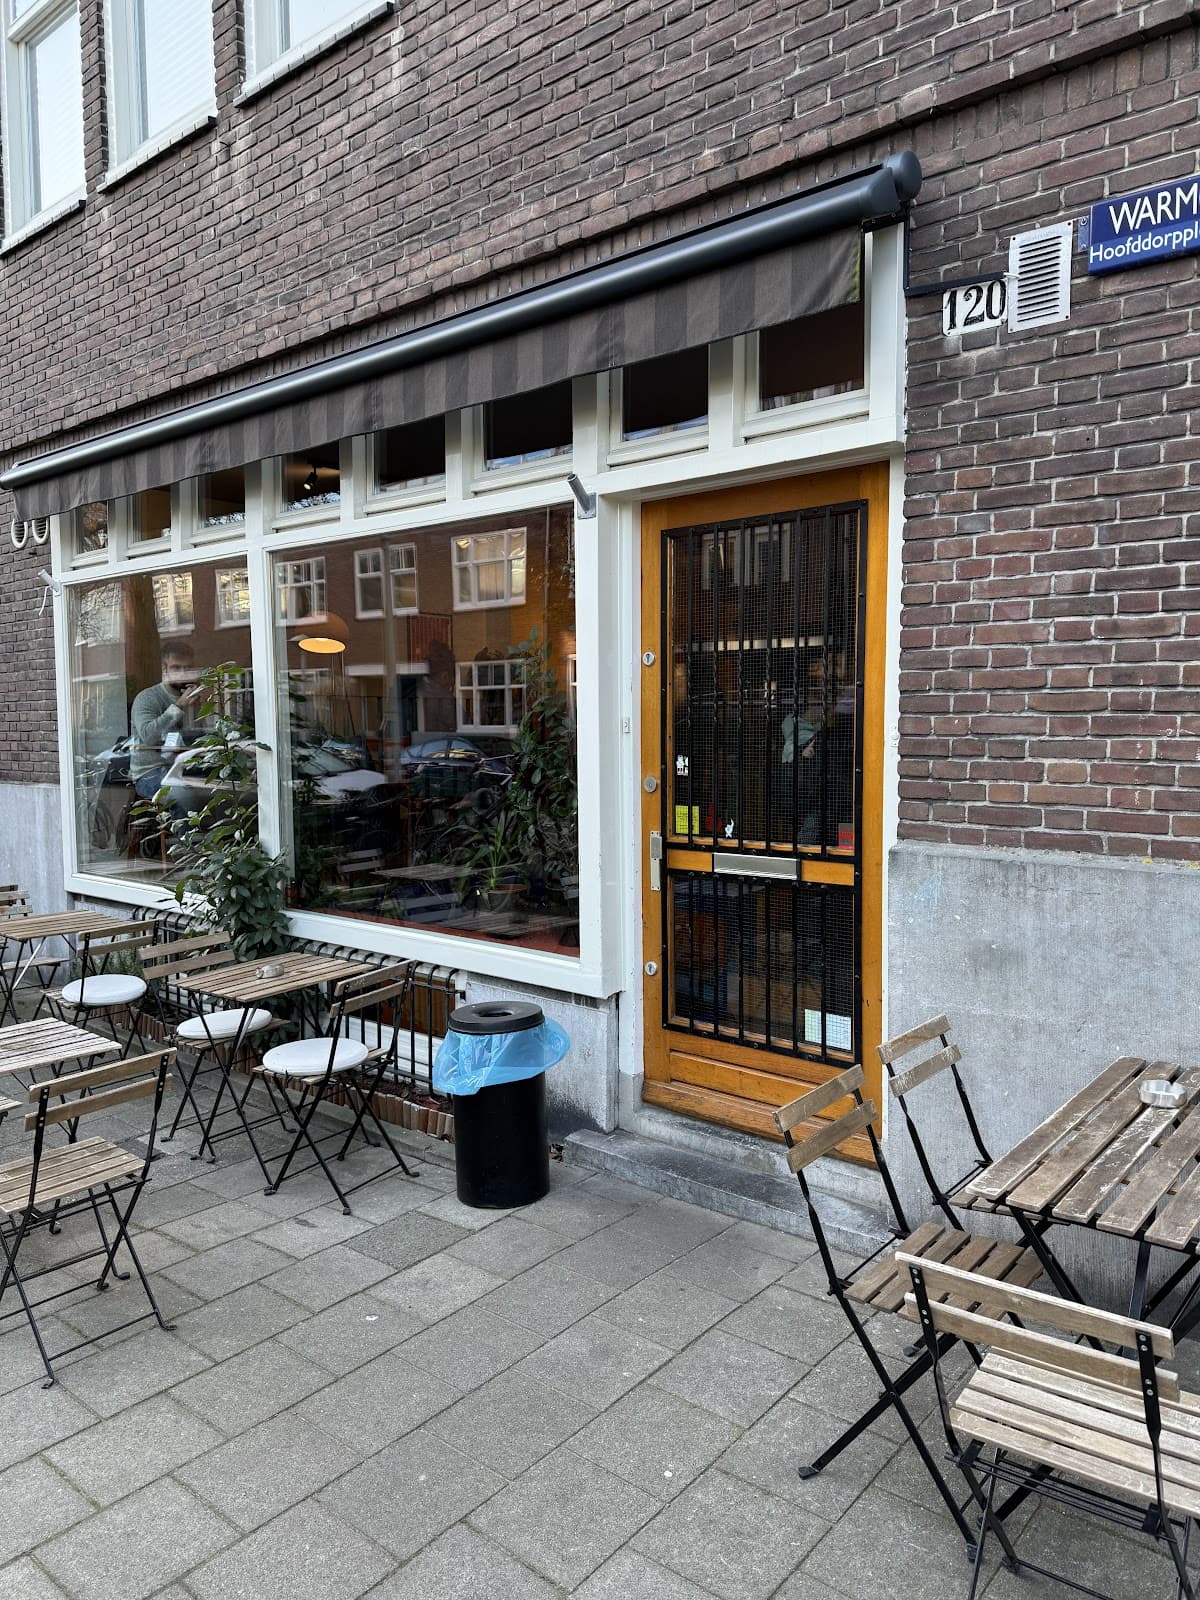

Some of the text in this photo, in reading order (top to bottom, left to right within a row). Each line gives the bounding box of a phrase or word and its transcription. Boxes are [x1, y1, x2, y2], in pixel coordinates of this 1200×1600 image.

[1108, 182, 1200, 235] WARM
[1089, 220, 1200, 264] Hoofddorppl
[944, 279, 1007, 331] 120
